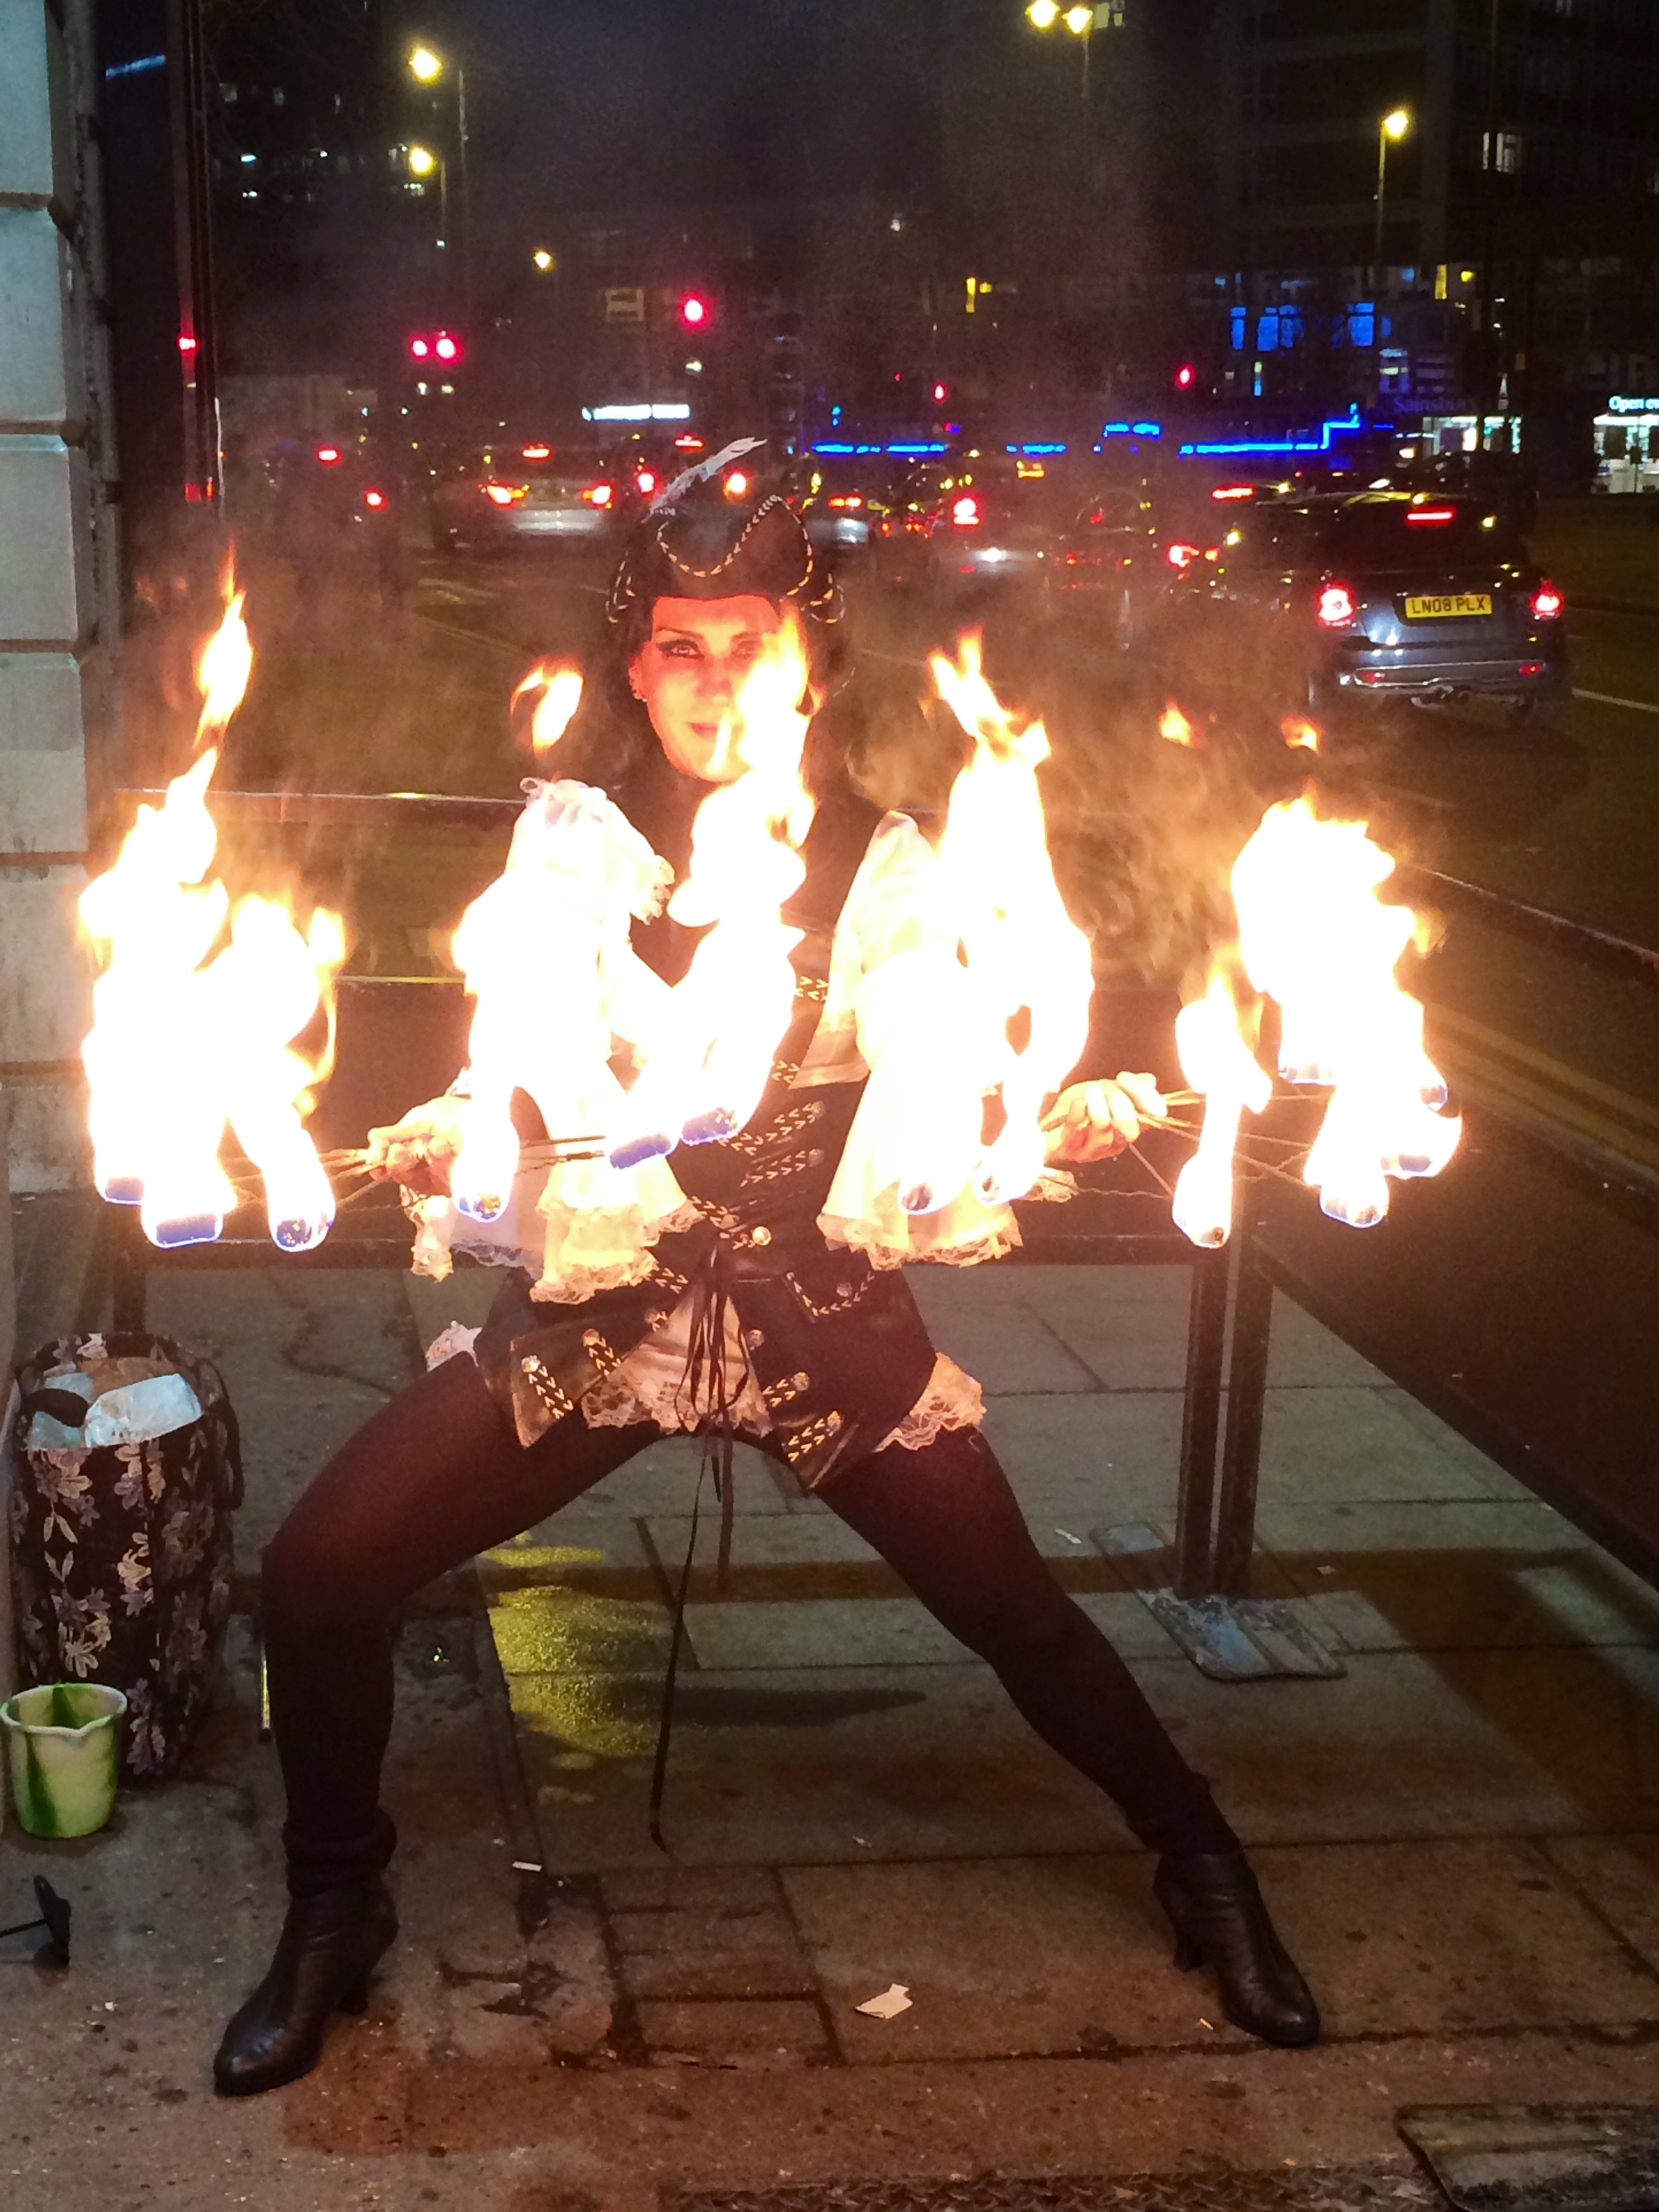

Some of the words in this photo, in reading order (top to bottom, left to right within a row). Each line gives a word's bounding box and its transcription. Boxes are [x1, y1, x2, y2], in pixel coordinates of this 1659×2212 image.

[1610, 396, 1644, 413] Open
[1411, 598, 1452, 614] LN08
[1456, 596, 1486, 611] PLX
